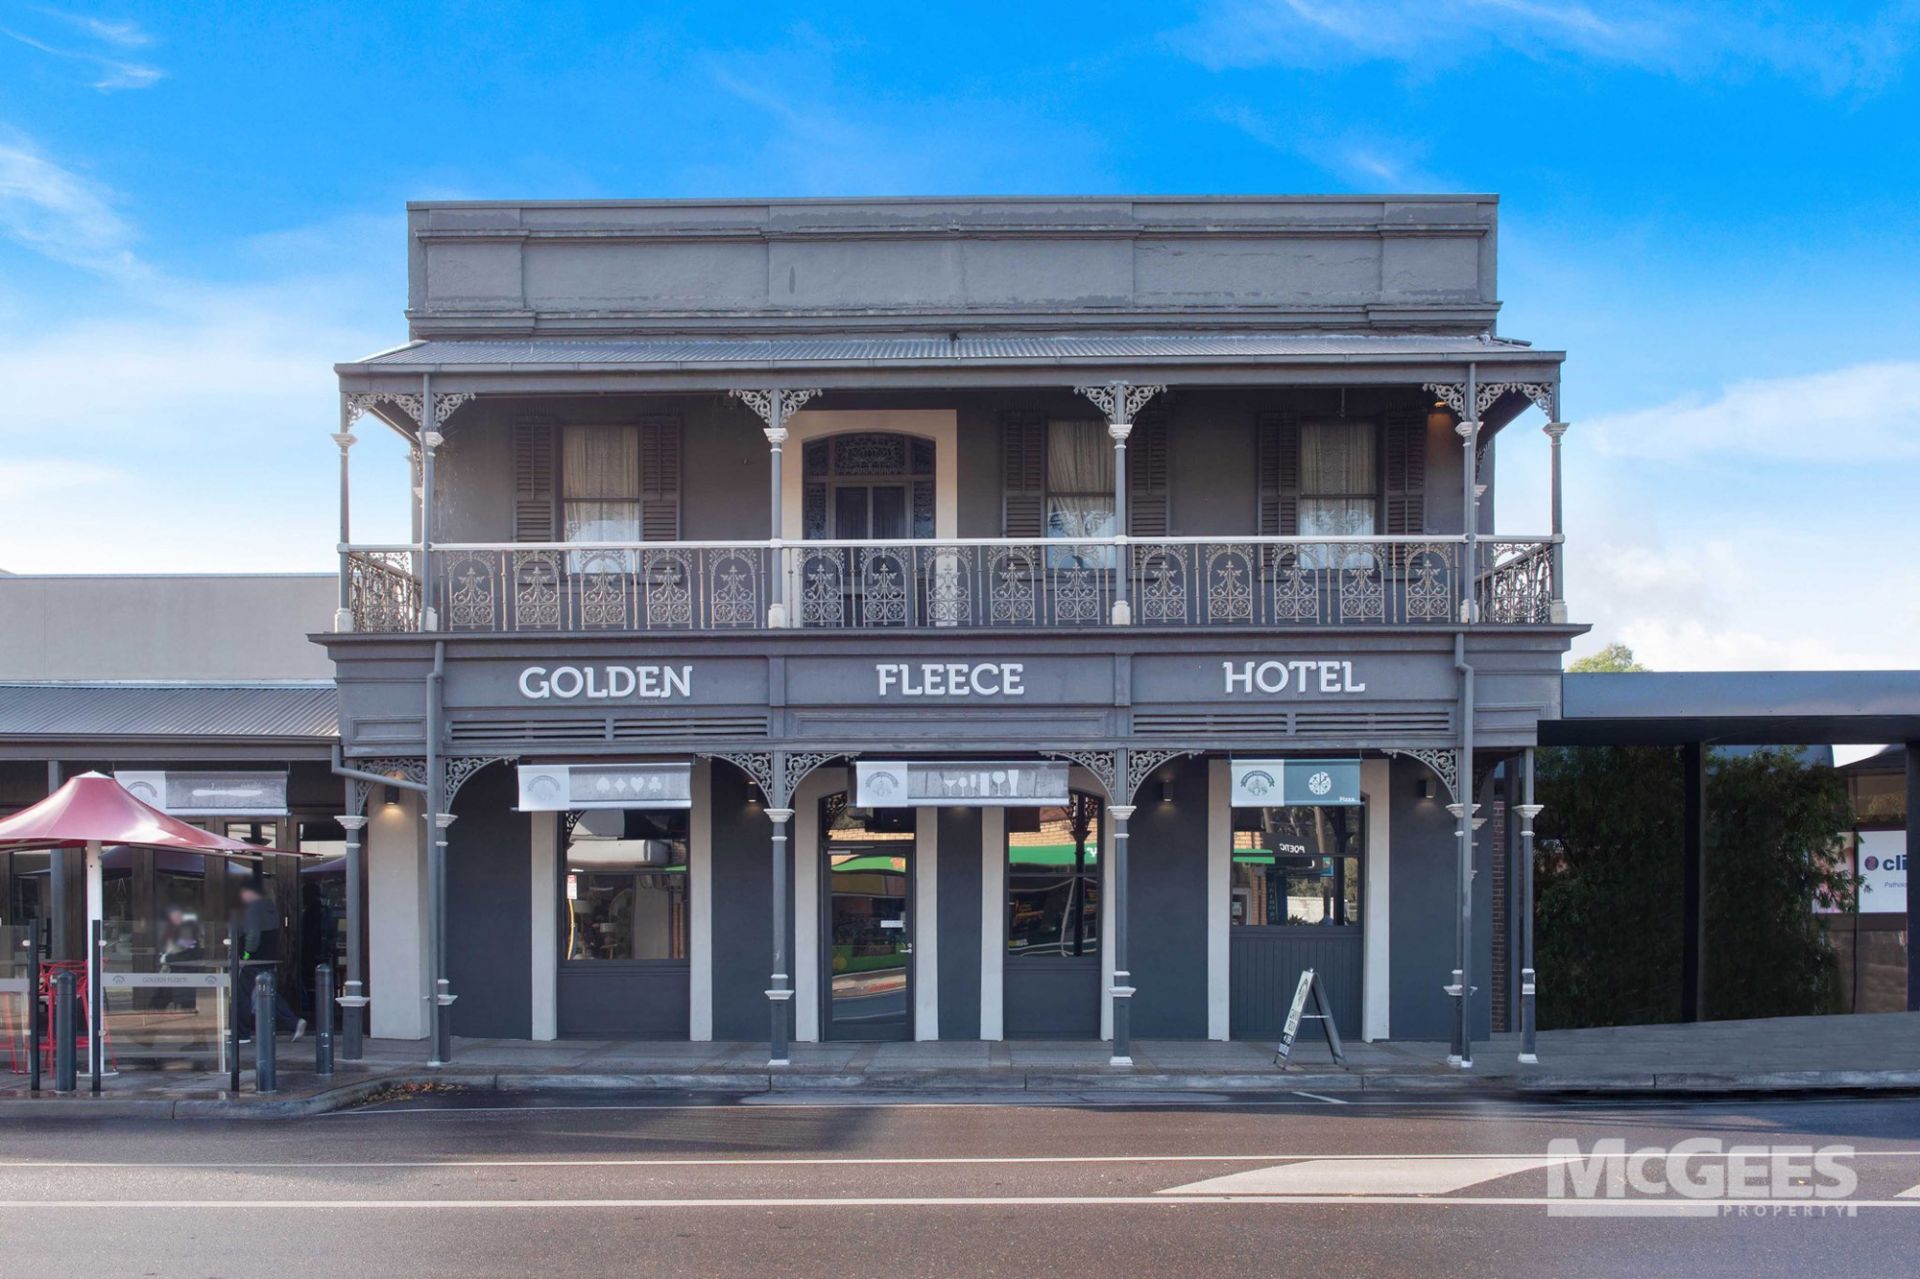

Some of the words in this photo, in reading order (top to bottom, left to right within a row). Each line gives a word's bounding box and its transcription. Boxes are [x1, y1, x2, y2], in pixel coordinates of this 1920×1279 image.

[518, 665, 693, 699] GOLDEN
[875, 662, 1025, 697] FLEECE
[1222, 660, 1366, 694] HOTEL
